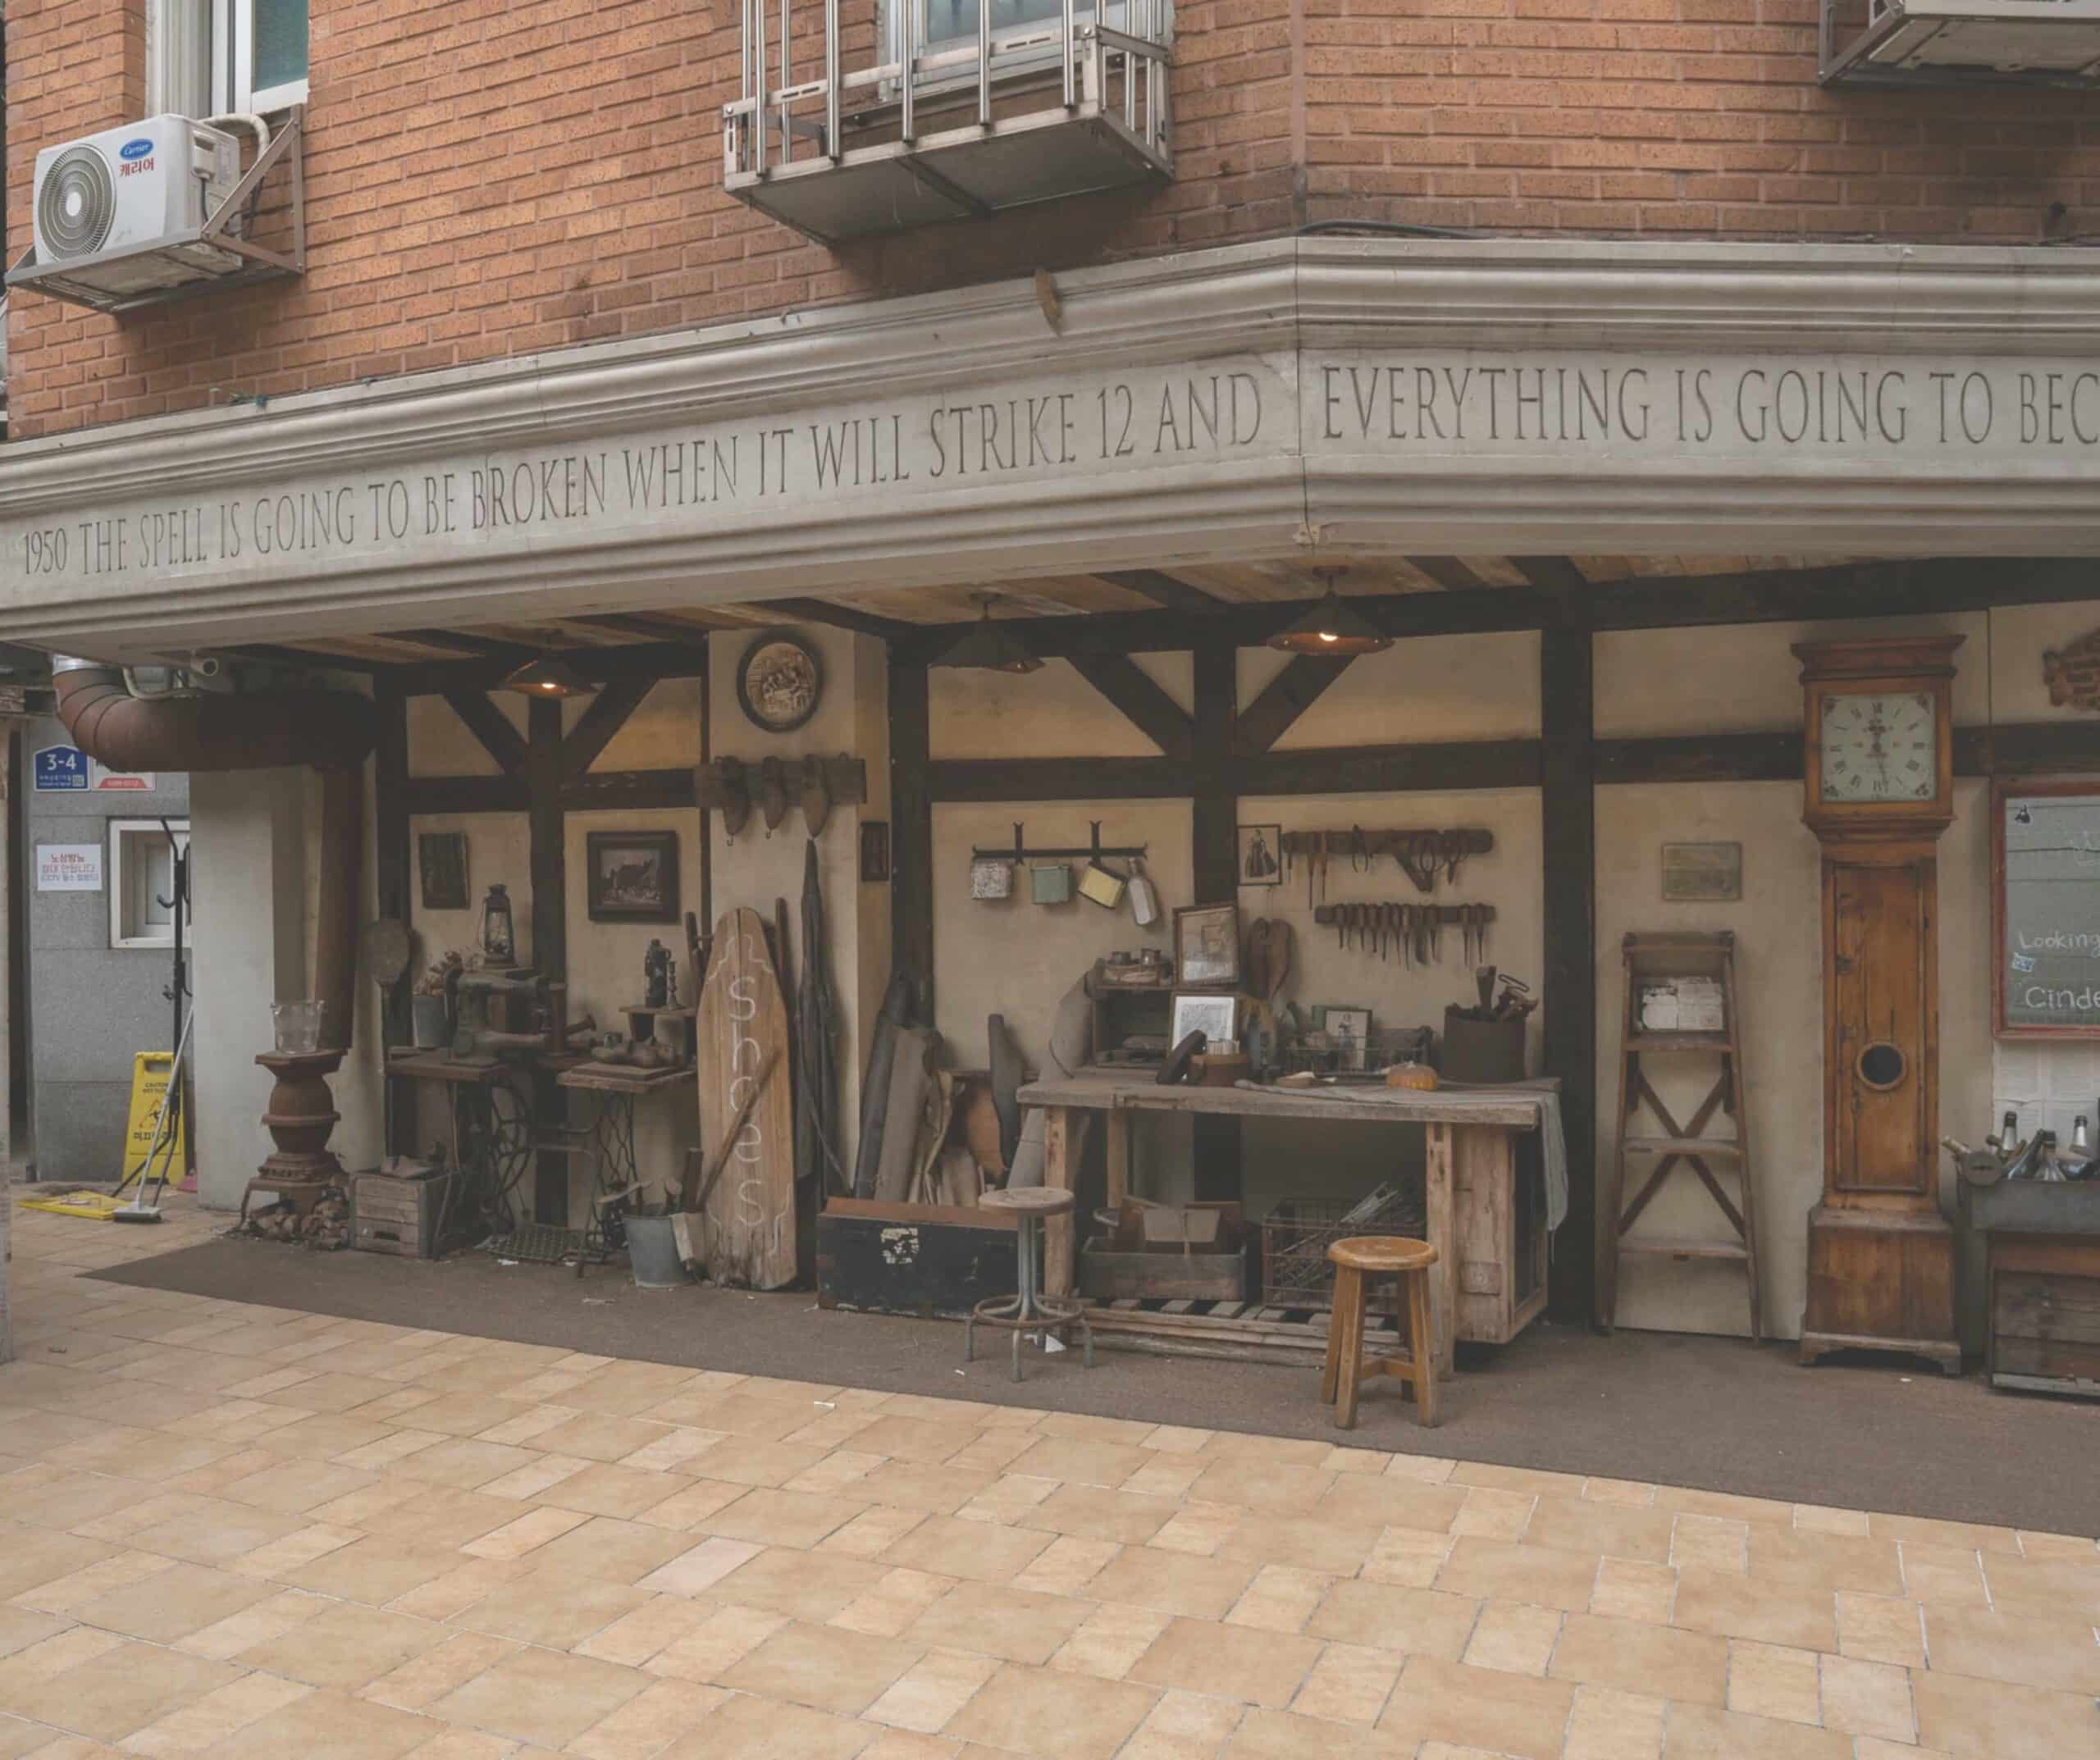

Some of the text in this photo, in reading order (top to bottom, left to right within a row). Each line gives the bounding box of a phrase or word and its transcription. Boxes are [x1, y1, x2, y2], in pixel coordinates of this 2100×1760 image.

[119, 157, 154, 177] 캐리어
[1322, 366, 2099, 445] EVERYTHING IS GOING TO BEC
[23, 372, 1262, 574] 1950 THE SPELL IS GOING TO BE BROKEN WHEN IT WILL STRIKE 12 AND
[46, 754, 77, 771] 3-4
